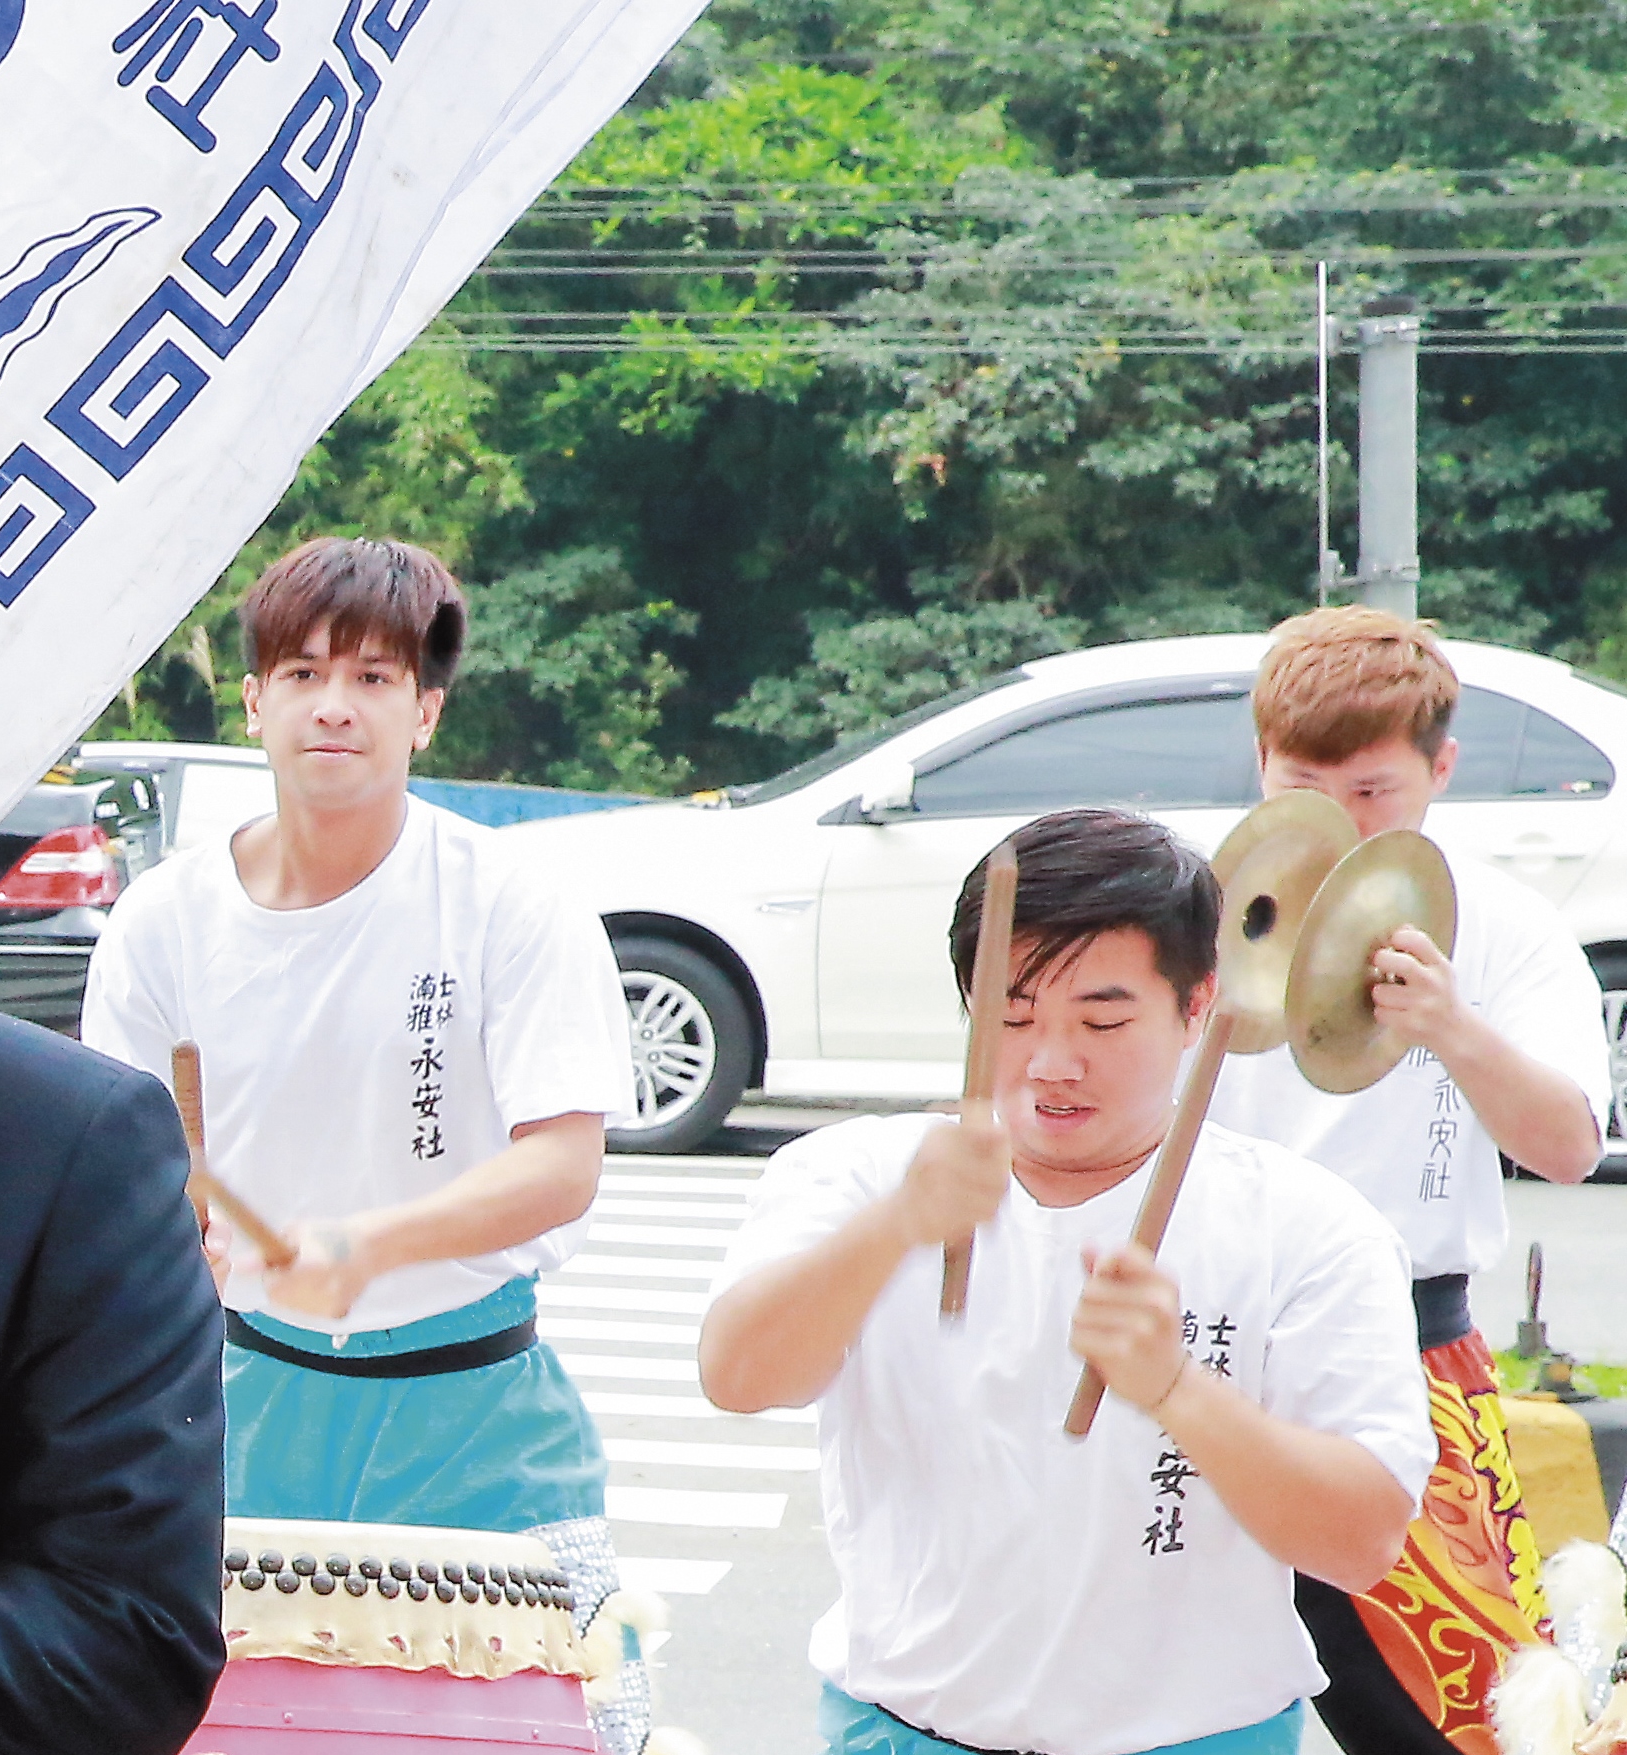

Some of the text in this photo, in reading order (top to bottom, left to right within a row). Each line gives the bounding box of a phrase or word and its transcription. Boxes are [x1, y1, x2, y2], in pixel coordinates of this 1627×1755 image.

[410, 1037, 445, 1160] 永安社
[1142, 1440, 1200, 1556] 安社
